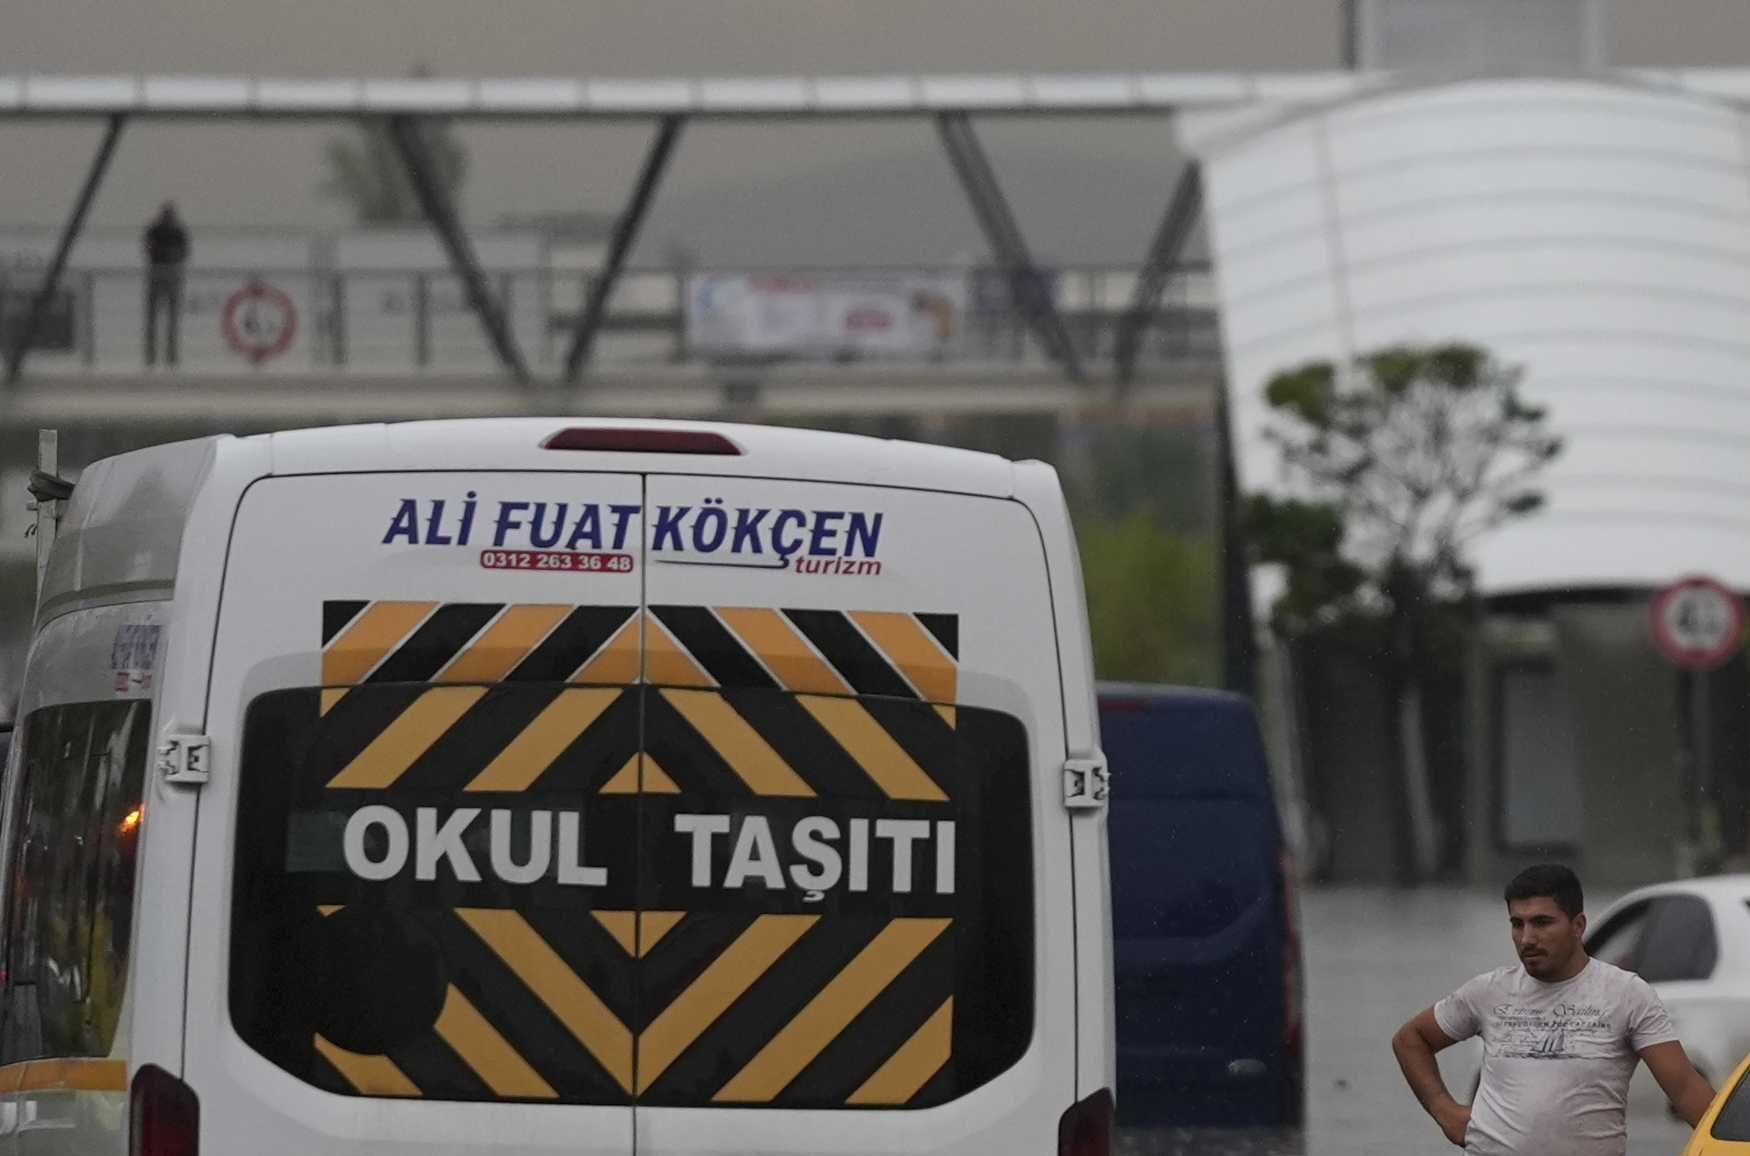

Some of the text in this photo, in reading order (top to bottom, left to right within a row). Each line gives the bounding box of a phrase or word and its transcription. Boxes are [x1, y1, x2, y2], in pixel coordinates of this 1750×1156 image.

[381, 490, 884, 568] ALİ FUAT KÖKÇEN
[482, 552, 632, 572] 0312 263 36 48
[795, 555, 883, 576] turizm
[342, 804, 957, 901] OKUL TAŞITI
